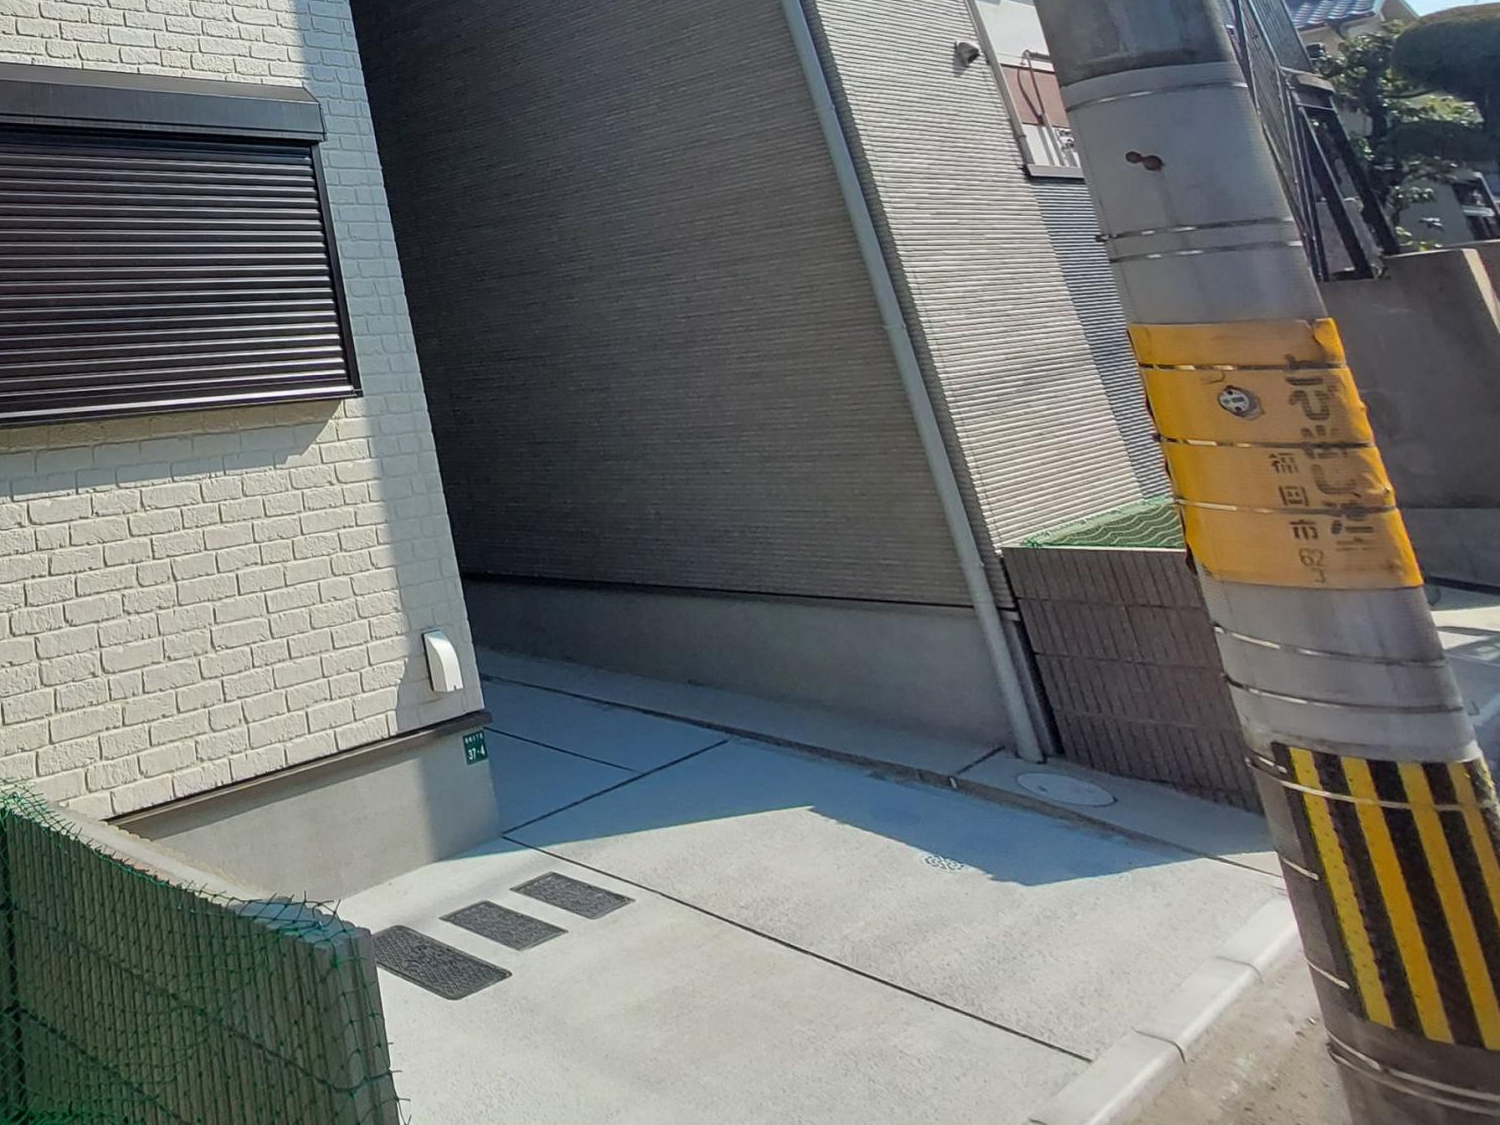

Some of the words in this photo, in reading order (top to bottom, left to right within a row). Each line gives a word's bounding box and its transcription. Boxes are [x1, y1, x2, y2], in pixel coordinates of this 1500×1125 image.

[1284, 353, 1384, 572] とび出し注
